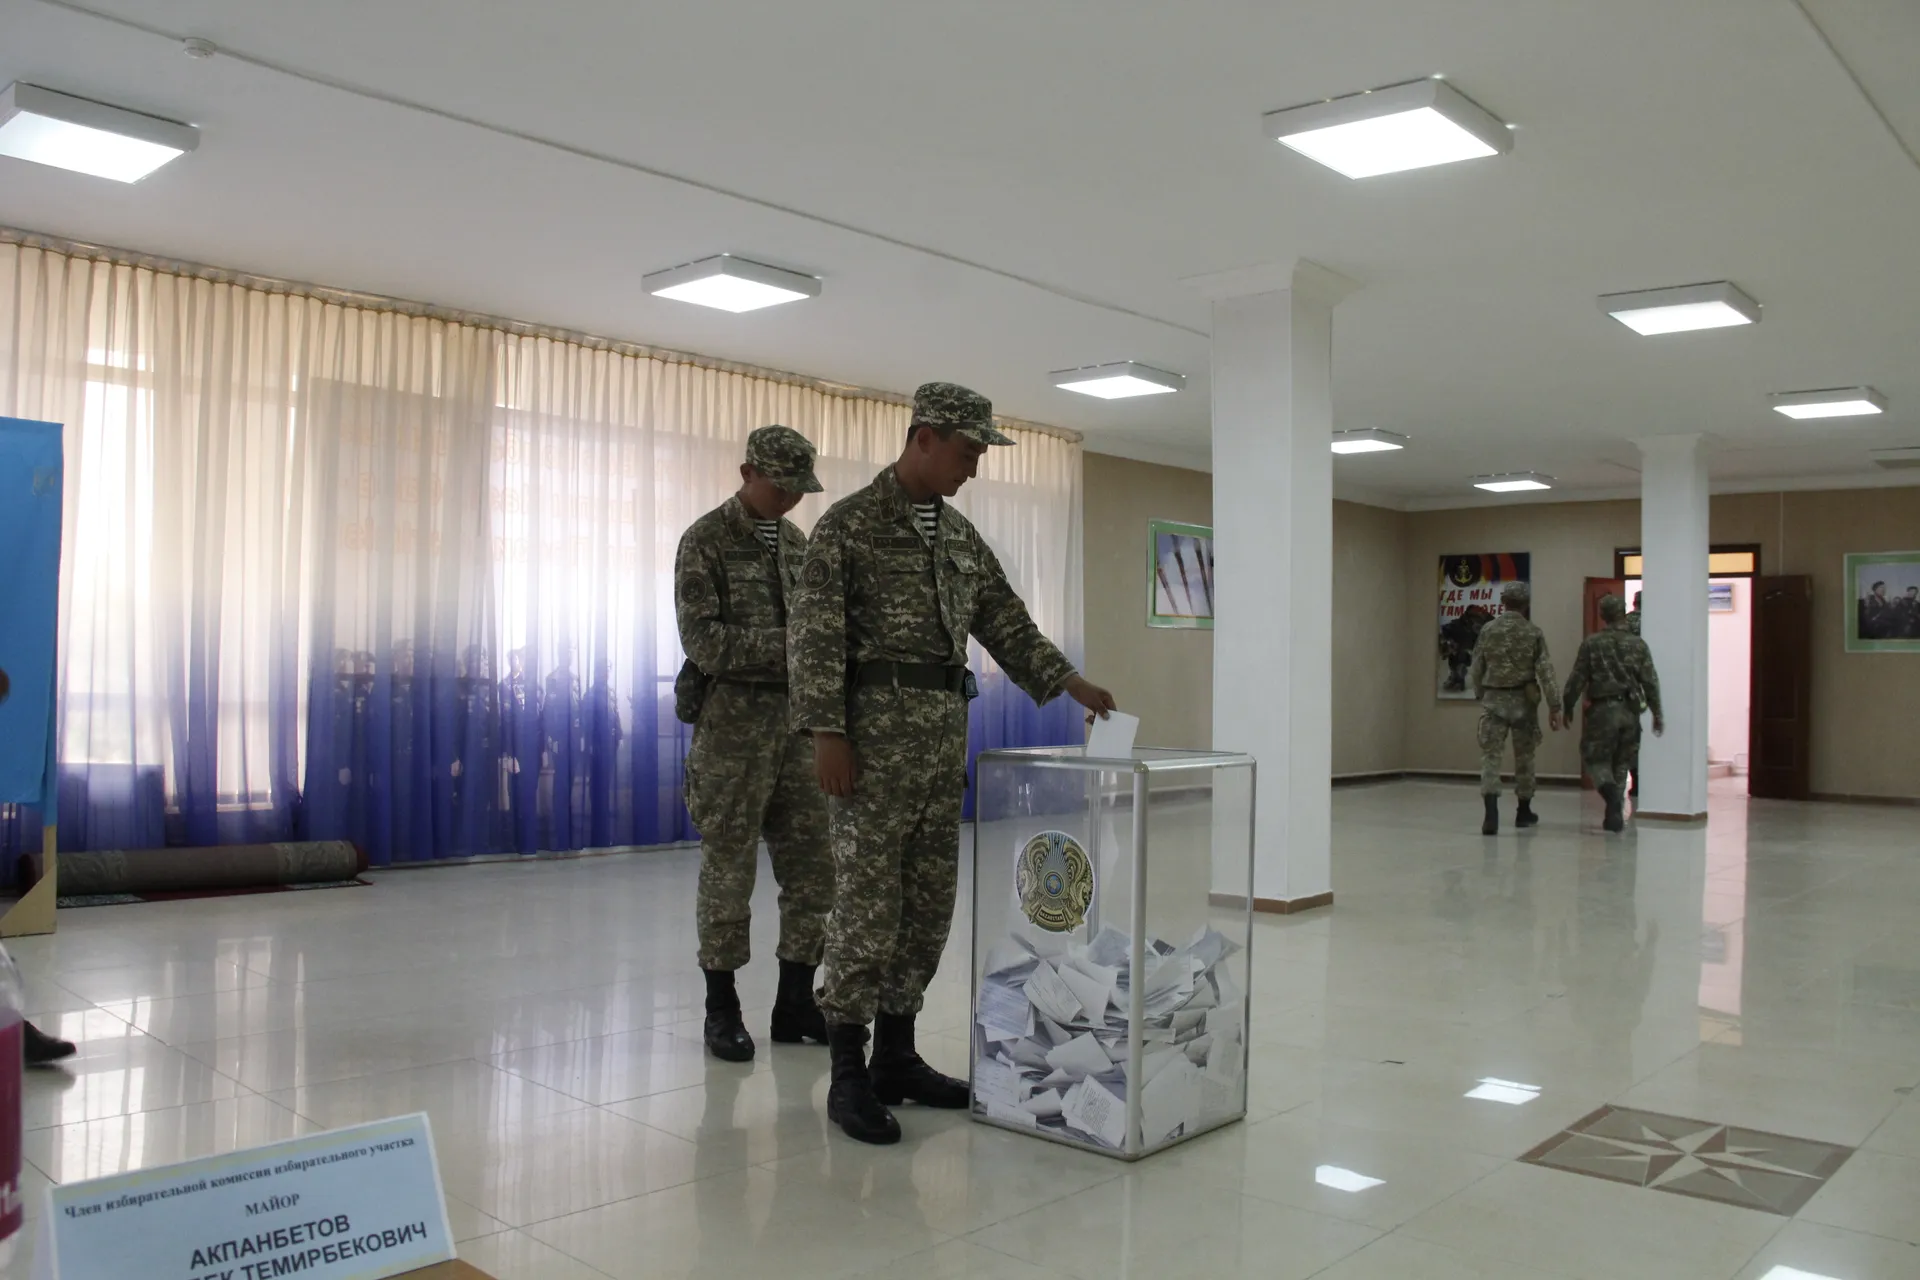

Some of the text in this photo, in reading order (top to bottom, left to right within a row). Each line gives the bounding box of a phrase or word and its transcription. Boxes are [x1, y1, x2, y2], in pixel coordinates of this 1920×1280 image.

[1440, 588, 1493, 603] ГДЕ МЫ
[65, 1137, 415, 1218] Член избирательной комиссии избирательного участка
[245, 1193, 300, 1216] МАЙОР
[190, 1214, 350, 1270] АКПАНБЕТОВ
[240, 1221, 428, 1280] ТЕМИРБЕКОВИЧ
